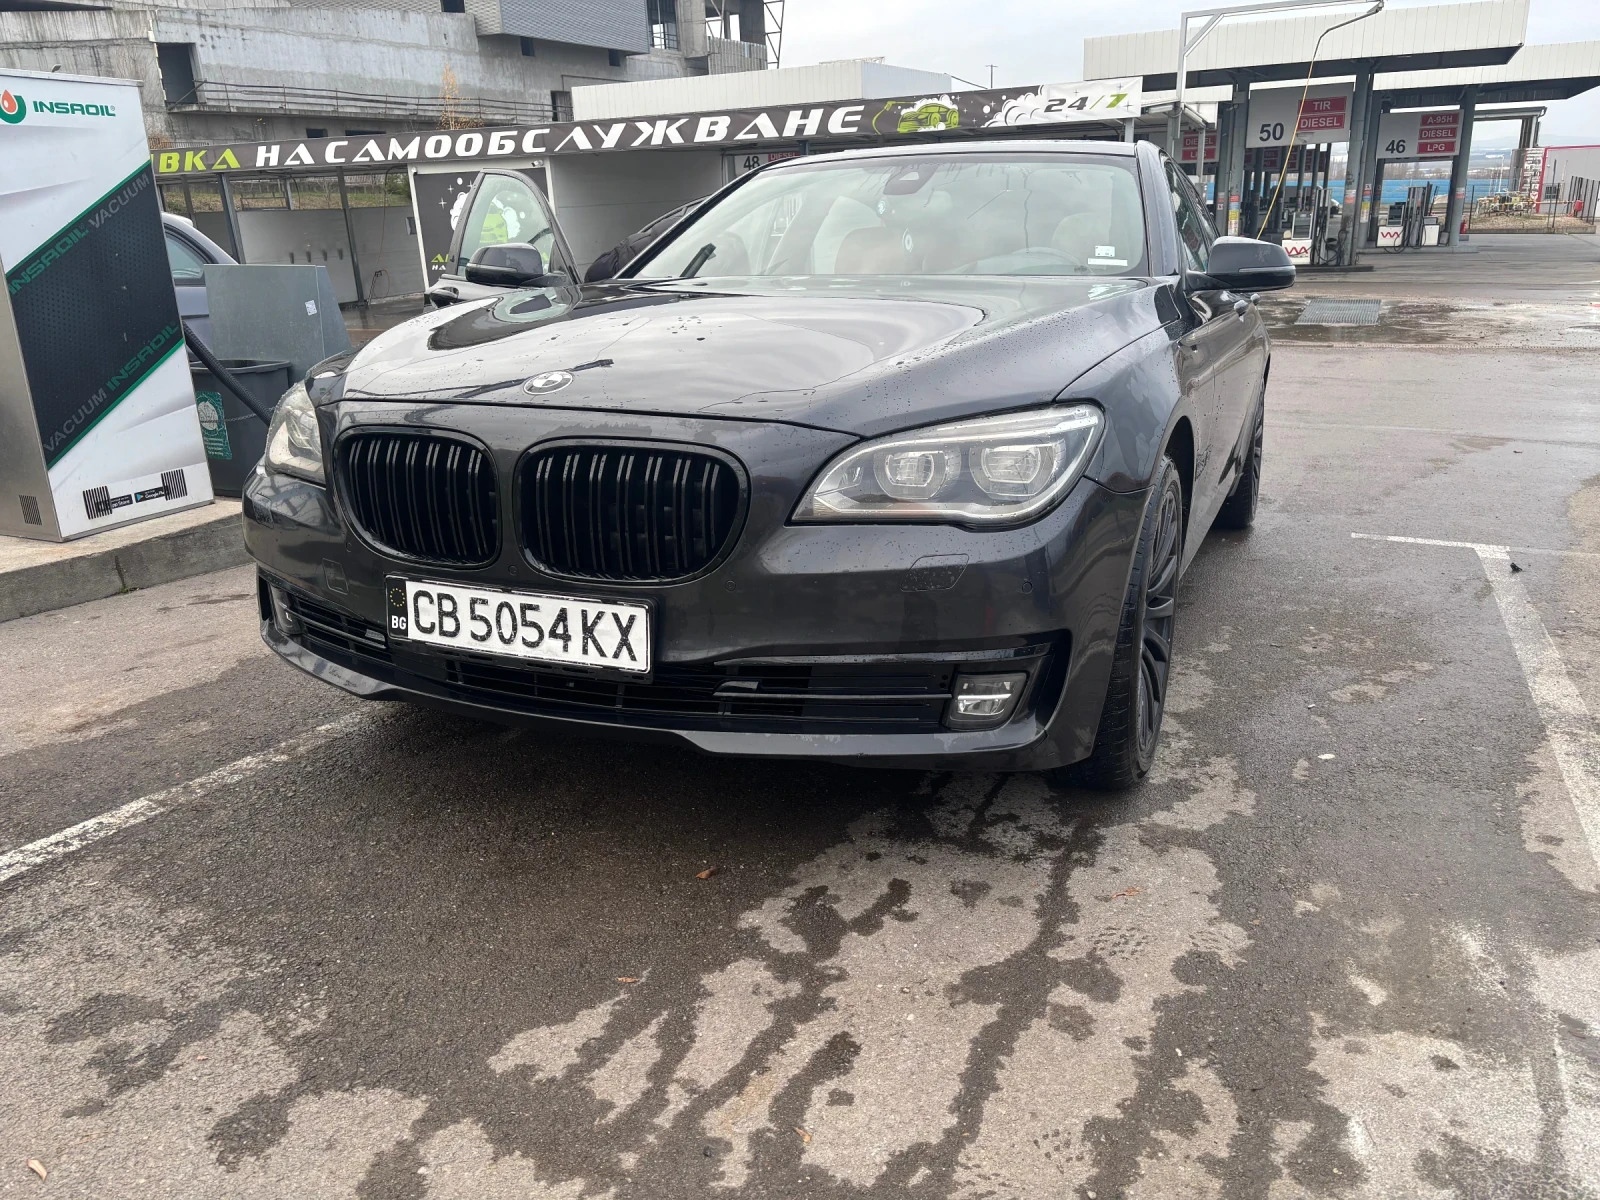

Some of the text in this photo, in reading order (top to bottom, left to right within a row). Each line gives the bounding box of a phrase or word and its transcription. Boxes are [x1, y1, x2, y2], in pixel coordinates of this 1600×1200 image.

[1044, 93, 1128, 113] 24/7
[1312, 100, 1331, 111] TIR
[1300, 117, 1340, 129] DIESEL
[1259, 122, 1284, 142] 50
[1422, 129, 1453, 138] DIESEL
[1185, 137, 1214, 146] DIEEL
[1385, 139, 1406, 154] 46
[1427, 143, 1446, 152] LPG
[150, 148, 241, 173] ВКА
[743, 155, 761, 171] 48
[89, 172, 150, 229] VACUUM
[44, 388, 107, 452] VACUUM
[391, 615, 407, 630] BG
